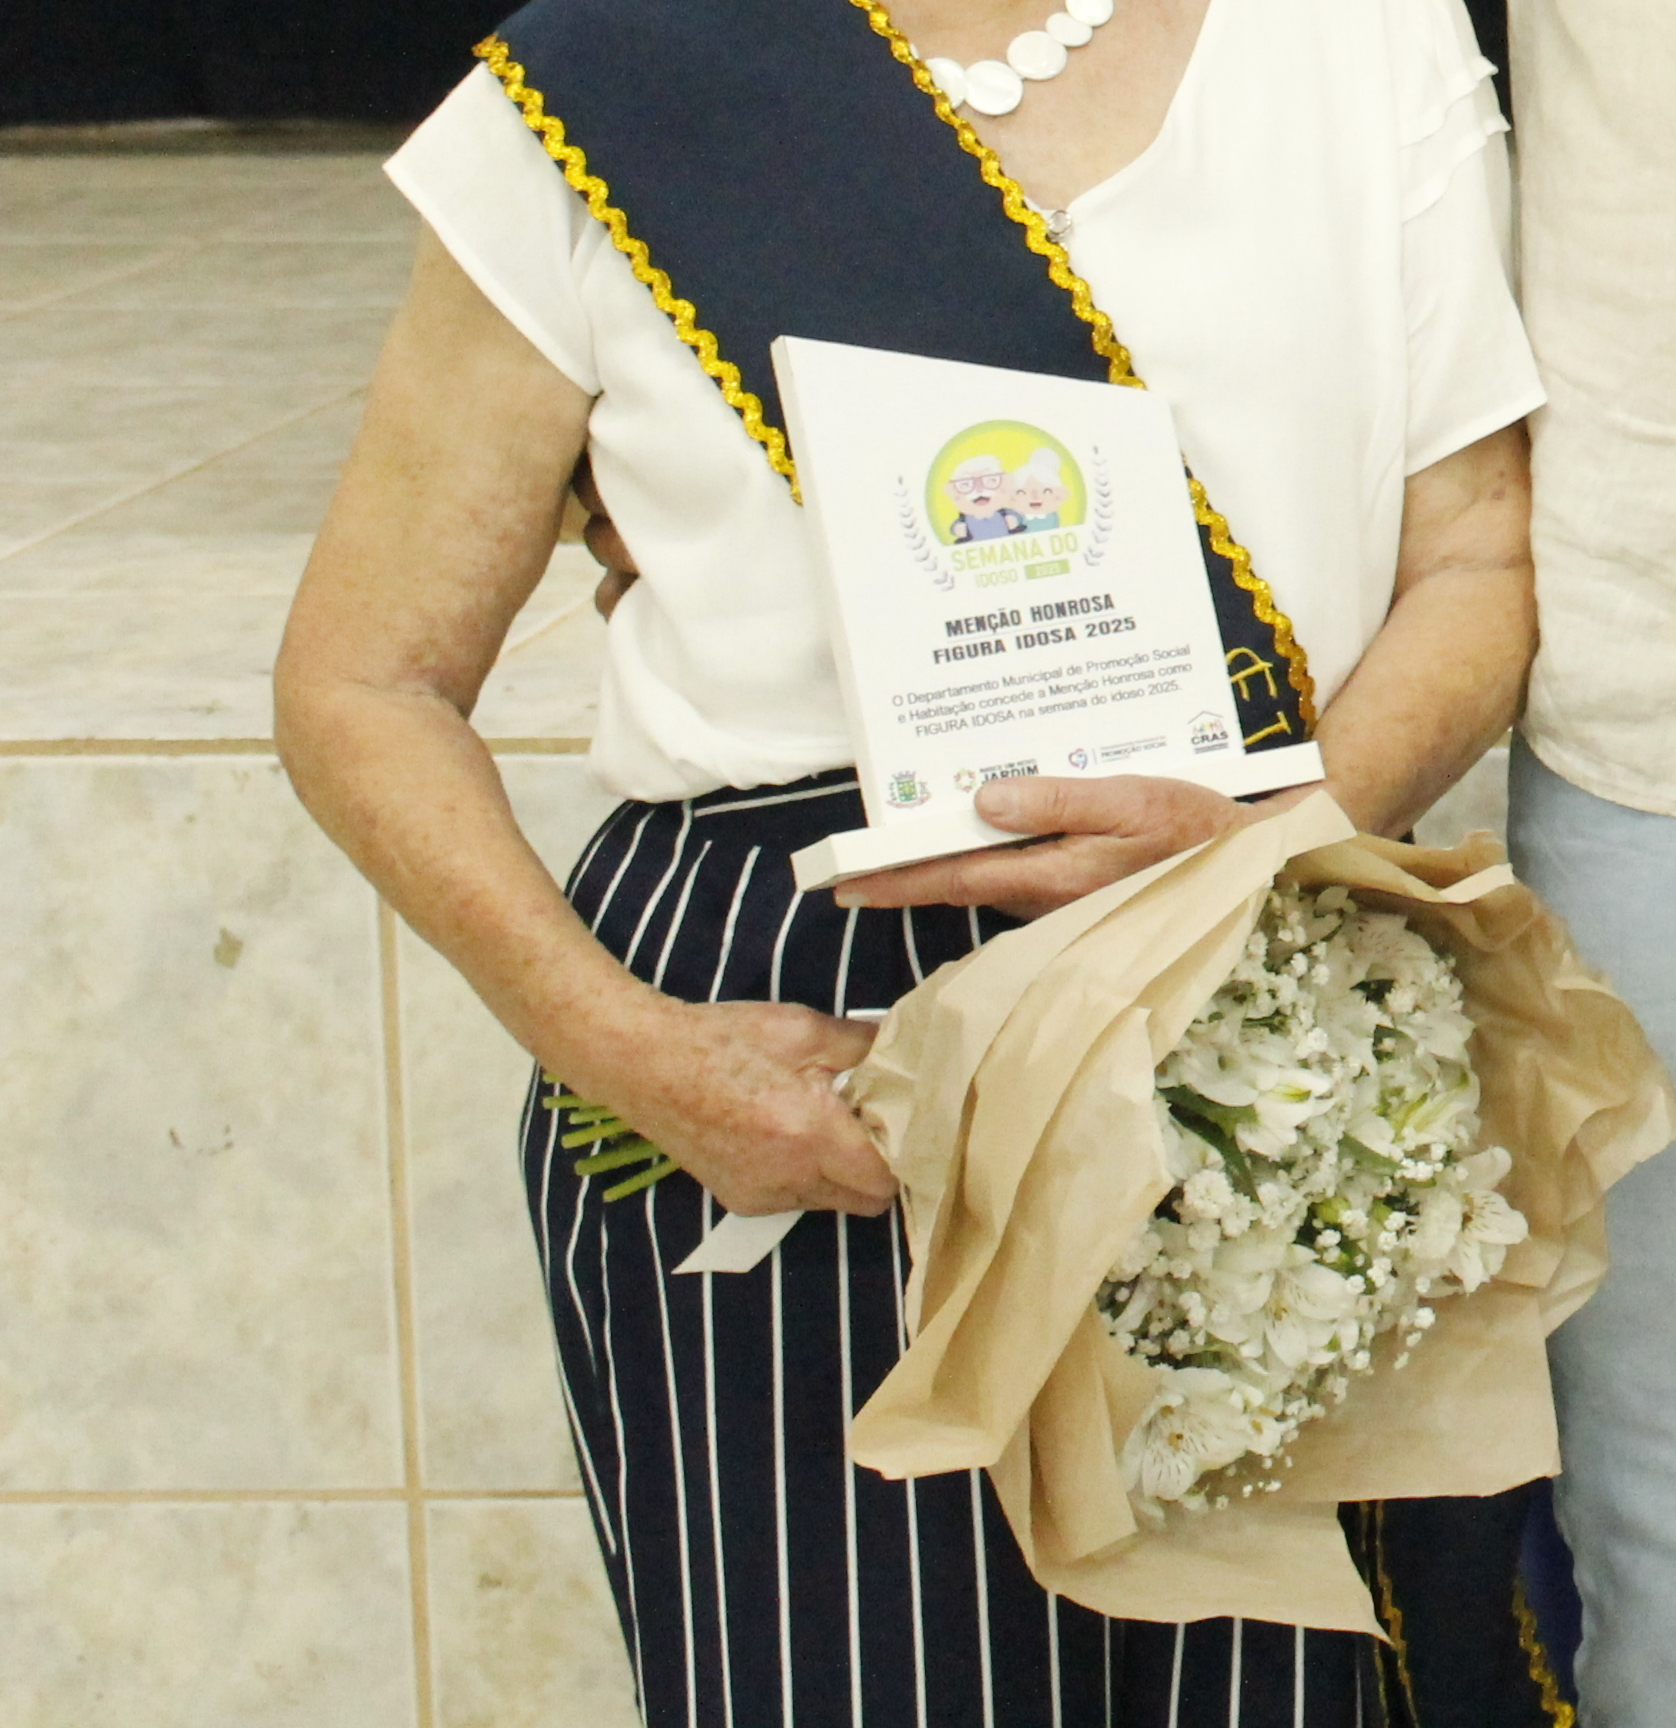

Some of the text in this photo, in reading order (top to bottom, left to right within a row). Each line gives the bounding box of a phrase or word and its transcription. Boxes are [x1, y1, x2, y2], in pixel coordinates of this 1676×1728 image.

[951, 532, 1079, 572] SEMANA DO
[975, 569, 1018, 588] IDOSO
[945, 593, 1115, 637] MENÇÃO HONROSA
[933, 616, 1137, 665] FIGURA IDOSA 2025
[892, 644, 1191, 708] O Departamento Municipal de Promoção Social
[897, 662, 1193, 724] e Habitação concede a Menção Honrosa como
[915, 719, 969, 737] FIGURA
[972, 710, 1016, 728] IDOSA
[1018, 707, 1035, 719] na
[1038, 699, 1088, 715] semana
[1091, 692, 1107, 706] do
[1111, 685, 1145, 702] idoso
[1191, 731, 1228, 746] CRAS
